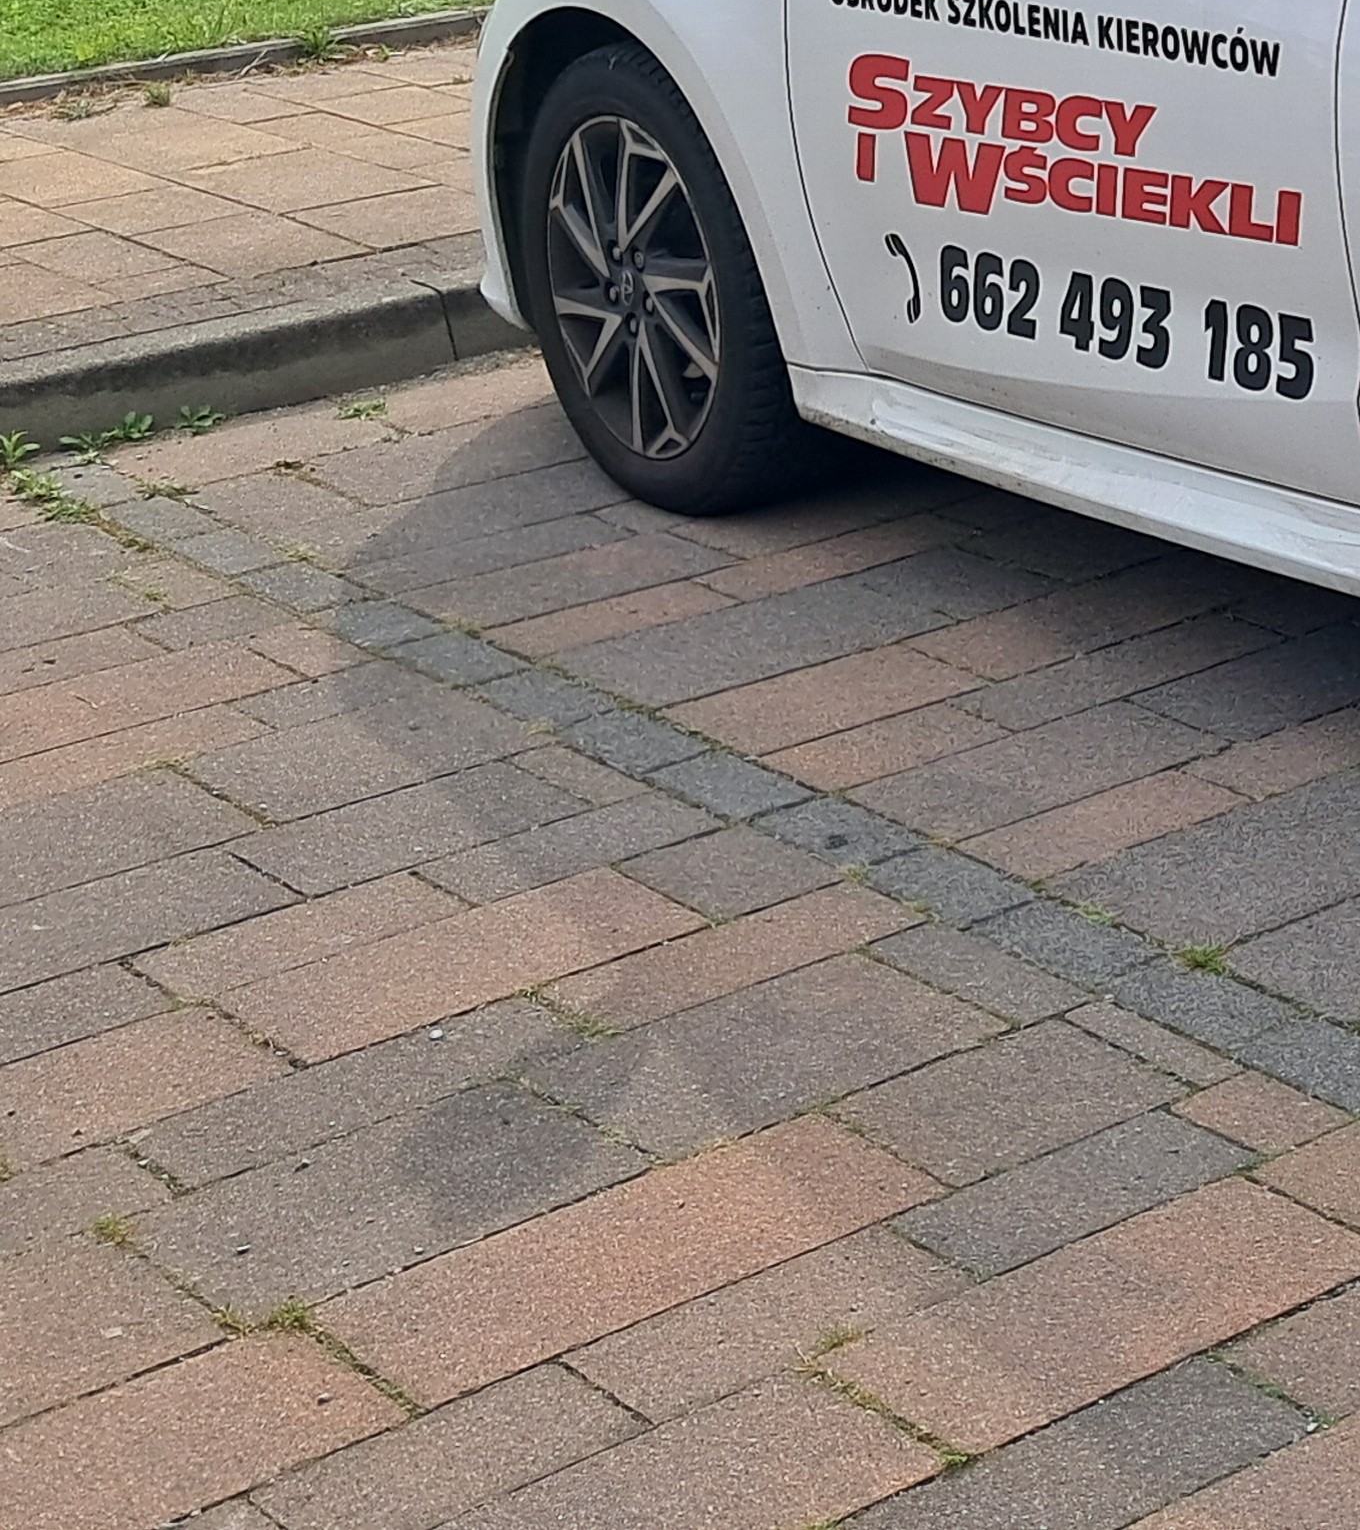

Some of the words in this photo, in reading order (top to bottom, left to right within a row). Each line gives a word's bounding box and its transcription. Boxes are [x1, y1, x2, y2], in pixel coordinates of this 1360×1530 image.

[1097, 15, 1280, 78] KIEROWCÓW
[856, 132, 877, 183] I
[939, 244, 1041, 341] 662
[1059, 270, 1172, 370] 493
[1204, 298, 1314, 401] 185
